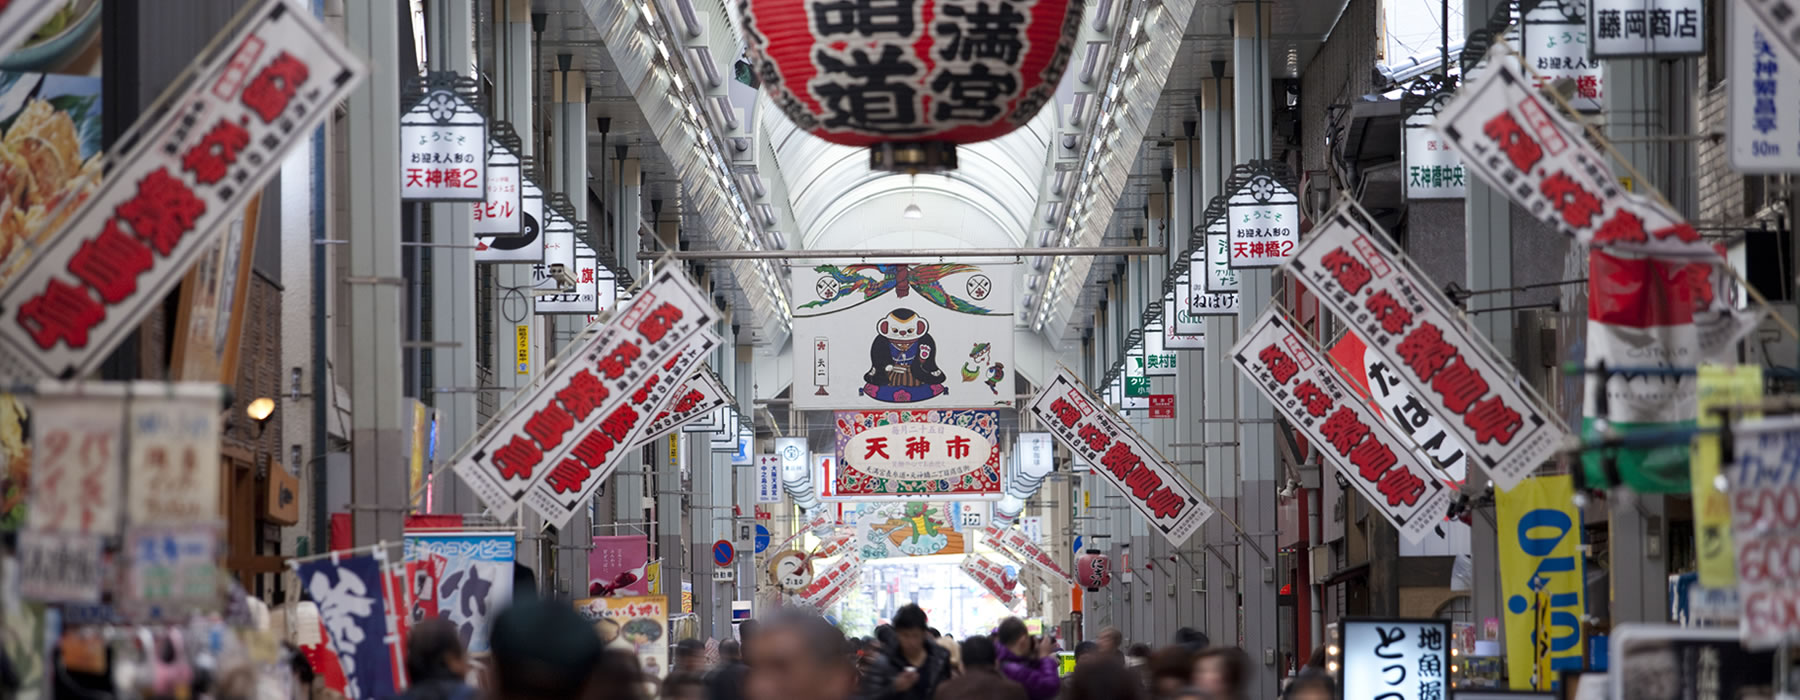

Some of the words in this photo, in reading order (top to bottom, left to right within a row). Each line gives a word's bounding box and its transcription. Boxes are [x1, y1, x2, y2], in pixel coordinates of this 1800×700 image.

[1598, 8, 1697, 39] 藤岡商店
[932, 0, 1026, 122] 満宮
[419, 131, 466, 146] ようこそ
[1752, 140, 1779, 157] 50m
[411, 152, 474, 164] お迎え人形の
[406, 168, 478, 189] 天神橋2
[1410, 165, 1464, 188] 天神橋中央
[1243, 210, 1282, 223] ようこそ
[1238, 228, 1290, 238] お迎え人形の
[1233, 240, 1294, 258] 天神橋2
[1368, 361, 1464, 470] たばこ
[891, 425, 945, 435] 毎月二十五日
[864, 435, 971, 460] 天神市
